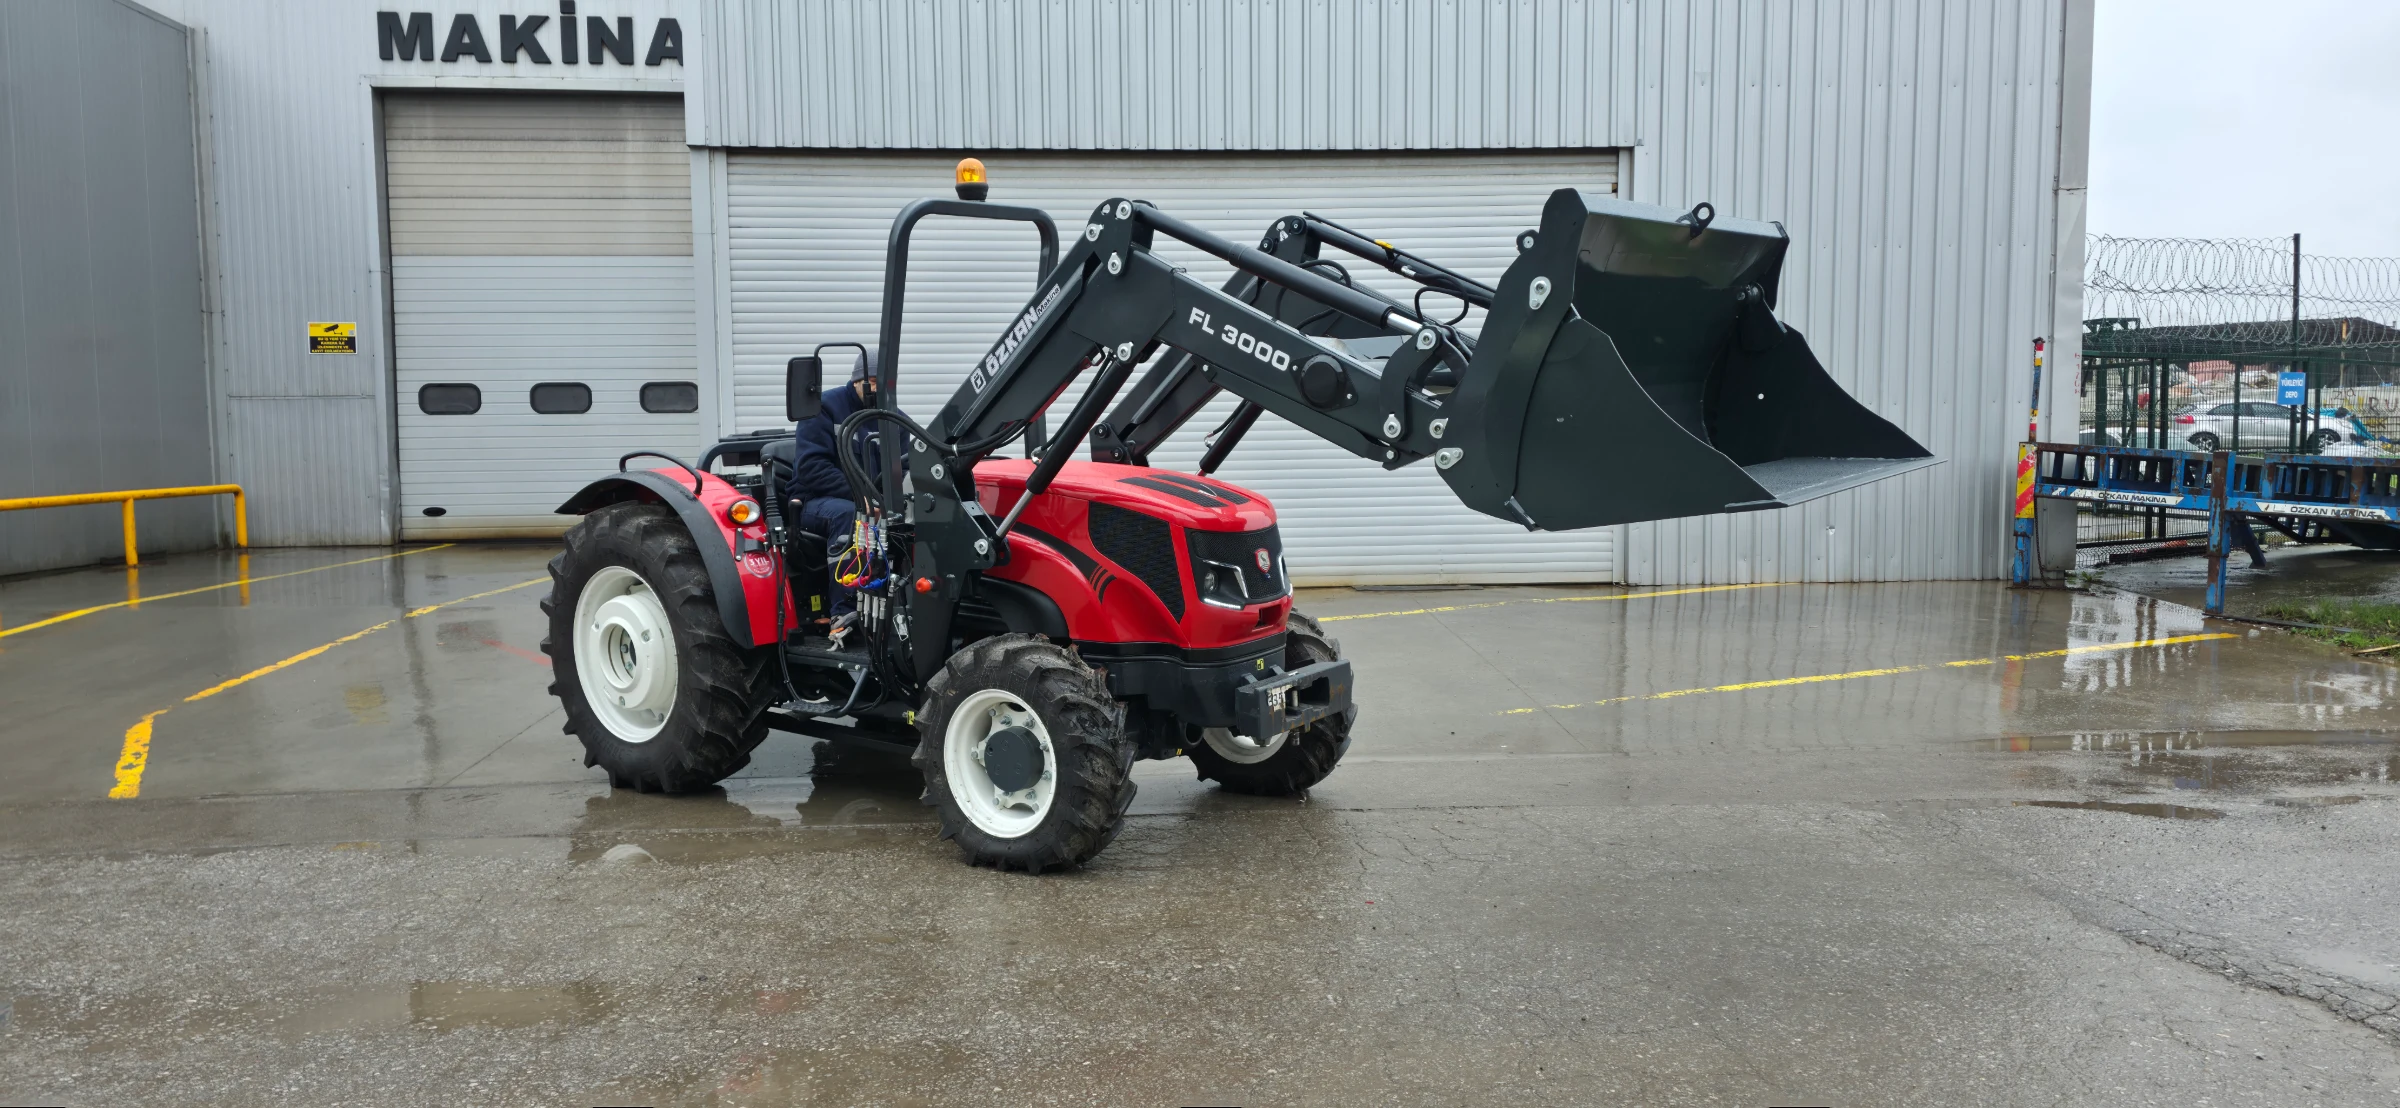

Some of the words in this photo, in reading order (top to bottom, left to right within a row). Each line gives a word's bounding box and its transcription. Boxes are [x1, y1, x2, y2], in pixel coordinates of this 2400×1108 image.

[376, 0, 684, 66] MAKİNA
[985, 305, 1039, 377] ÖZKAN
[1037, 284, 1061, 317] Makina
[1188, 306, 1215, 336] FL
[1221, 324, 1291, 372] 3000
[2285, 391, 2299, 399] DEPO
